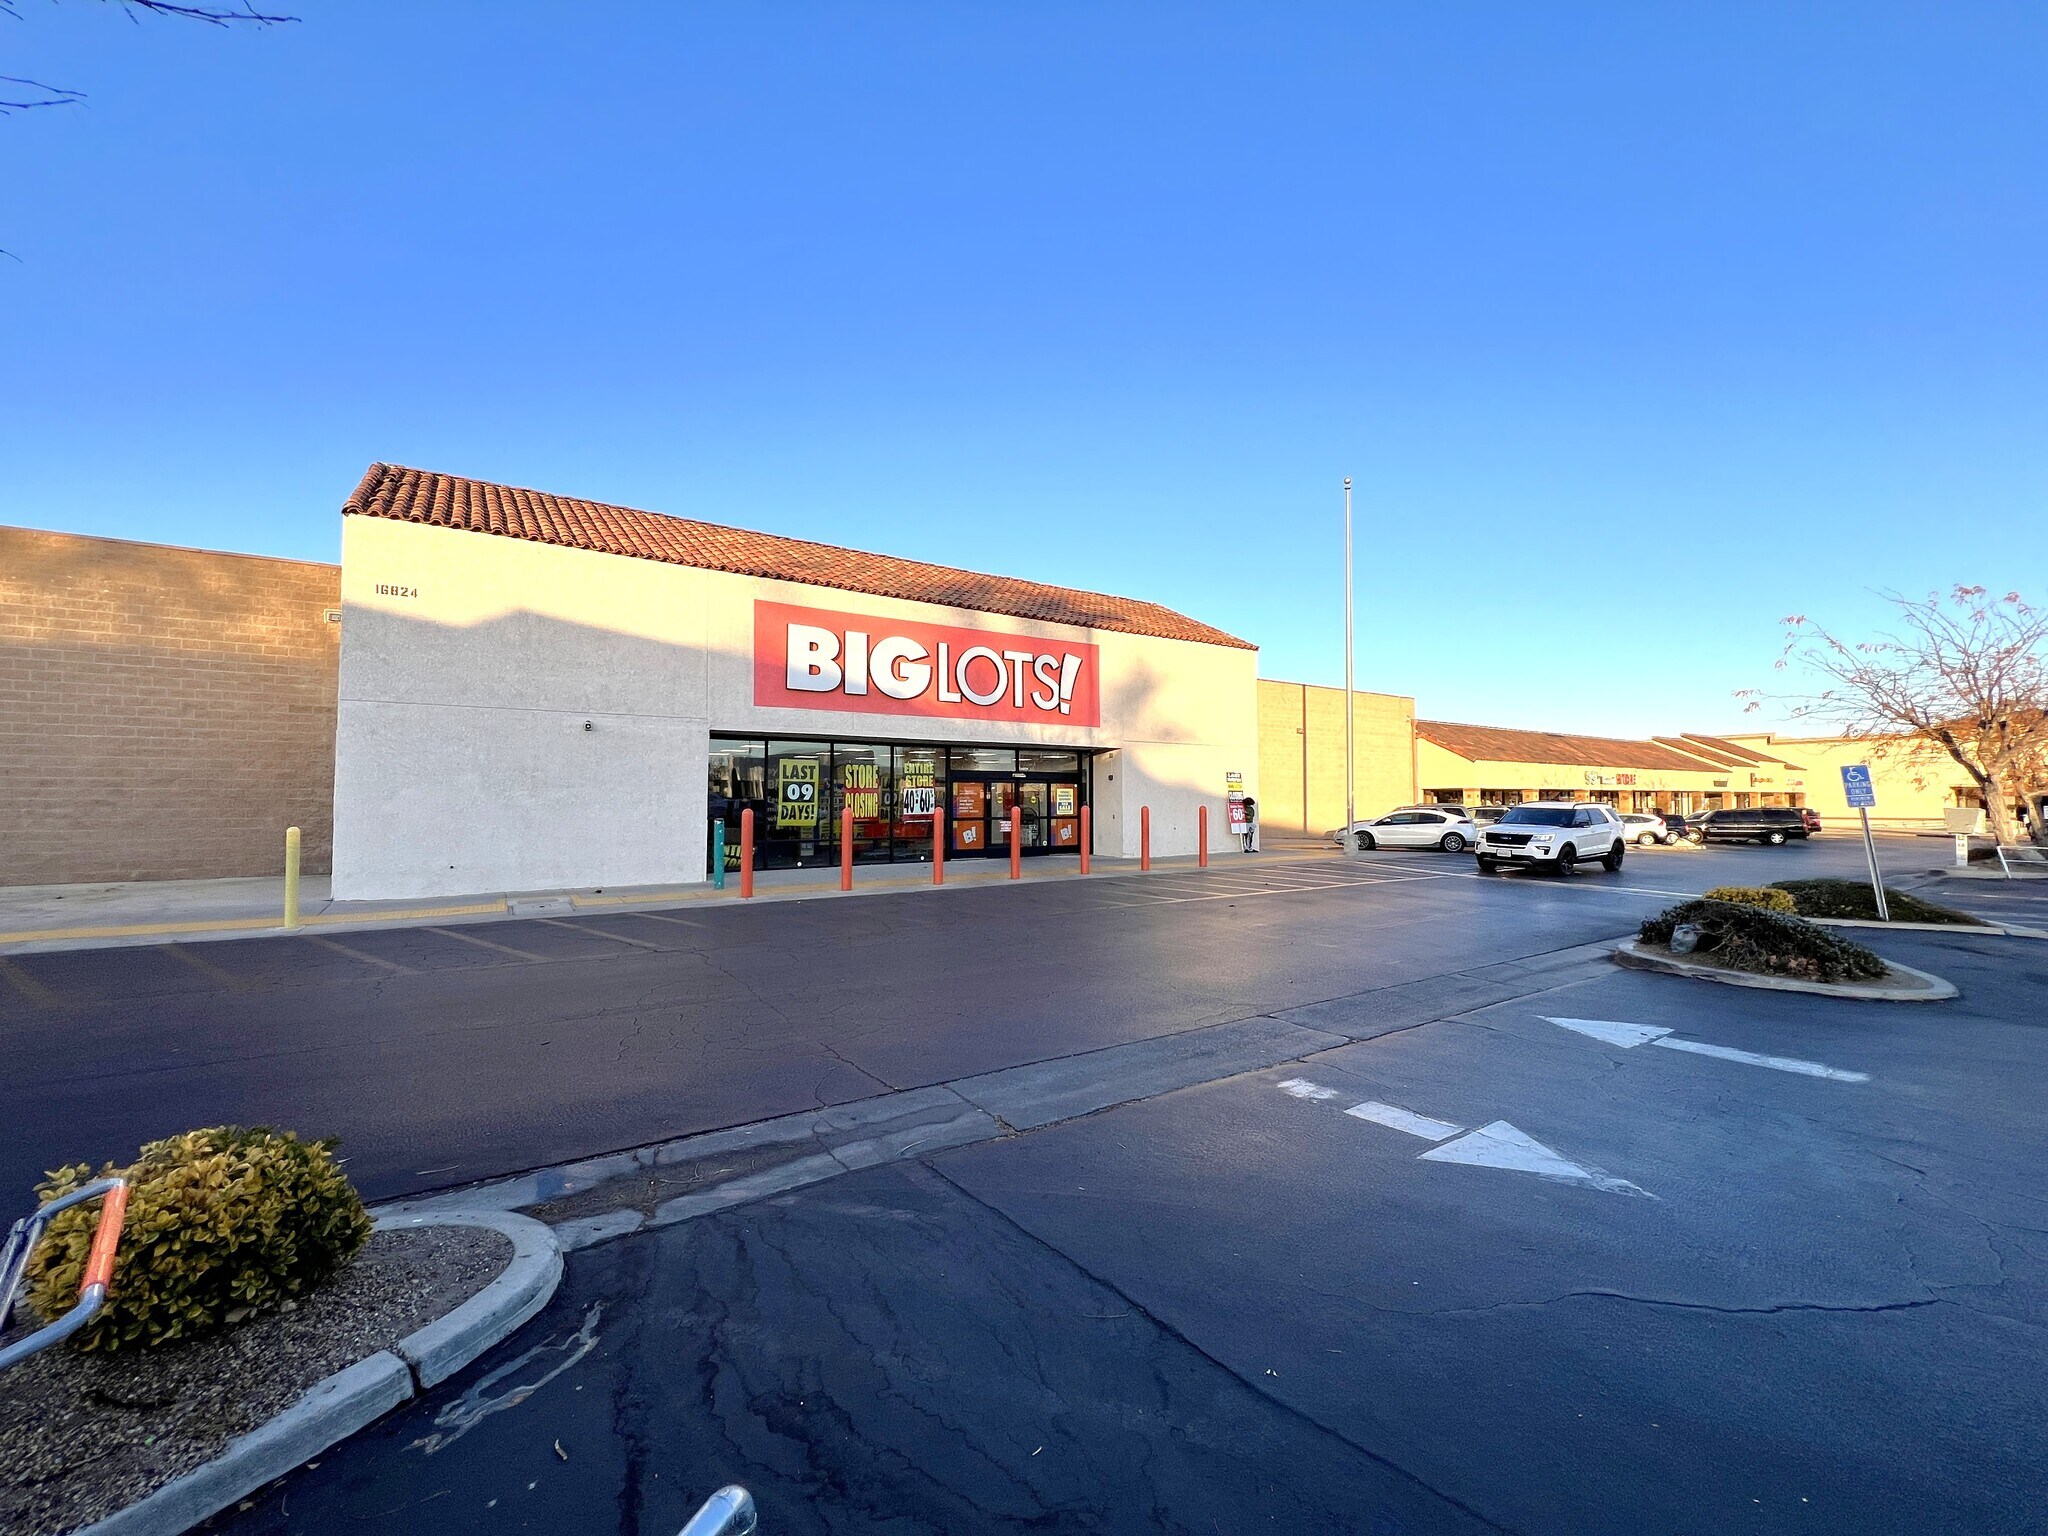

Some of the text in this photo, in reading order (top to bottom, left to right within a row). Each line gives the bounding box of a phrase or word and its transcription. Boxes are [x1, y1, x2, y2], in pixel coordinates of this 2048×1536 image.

[376, 584, 418, 598] 16824
[786, 623, 1083, 715] BIG LOTS!
[782, 764, 816, 780] LAST
[904, 762, 934, 774] ENTIRE
[845, 764, 879, 789] STORE
[905, 775, 934, 788] STORE
[787, 783, 814, 801] 09
[780, 804, 815, 820] DAYS!
[845, 792, 878, 818] CLOSING
